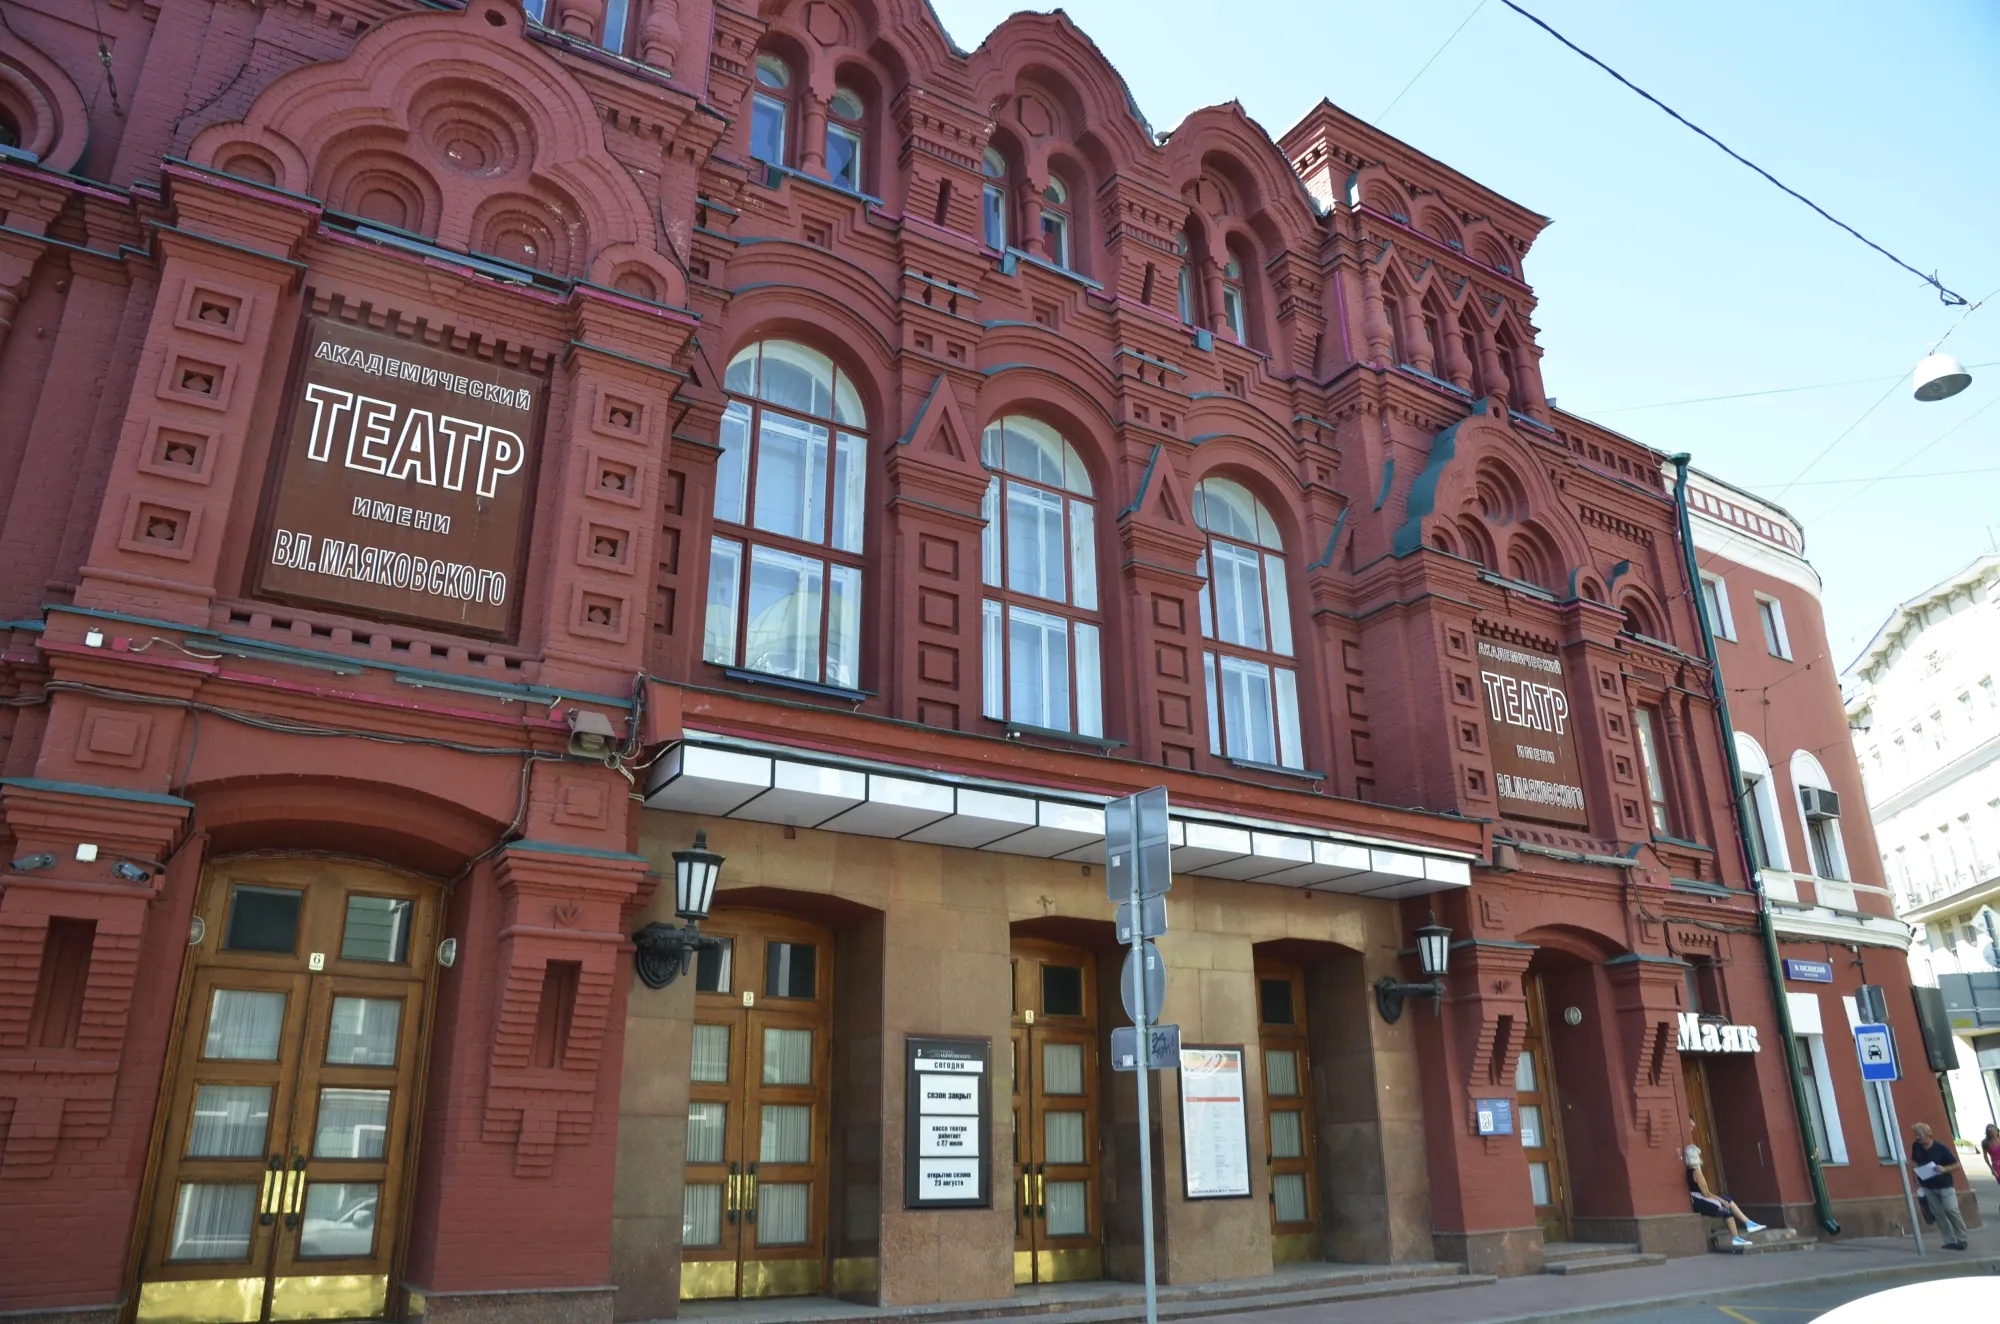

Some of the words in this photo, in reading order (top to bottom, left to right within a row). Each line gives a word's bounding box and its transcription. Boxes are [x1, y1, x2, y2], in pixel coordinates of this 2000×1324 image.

[315, 342, 531, 410] АКАДЕМИЧЕСКИЙ
[305, 383, 525, 498] ТЕАТР
[352, 497, 451, 534] ИМЕНИ
[1478, 642, 1562, 675] АКАДЕМИЧЕСКИЙ
[1481, 670, 1569, 735] ТЕАТР
[1516, 744, 1556, 764] ИМЕНИ
[313, 954, 321, 965] 6
[1676, 1012, 1761, 1053] Маяк
[934, 1061, 965, 1071] сегодня
[927, 1092, 947, 1100] сезон
[948, 1092, 972, 1101] закрыт
